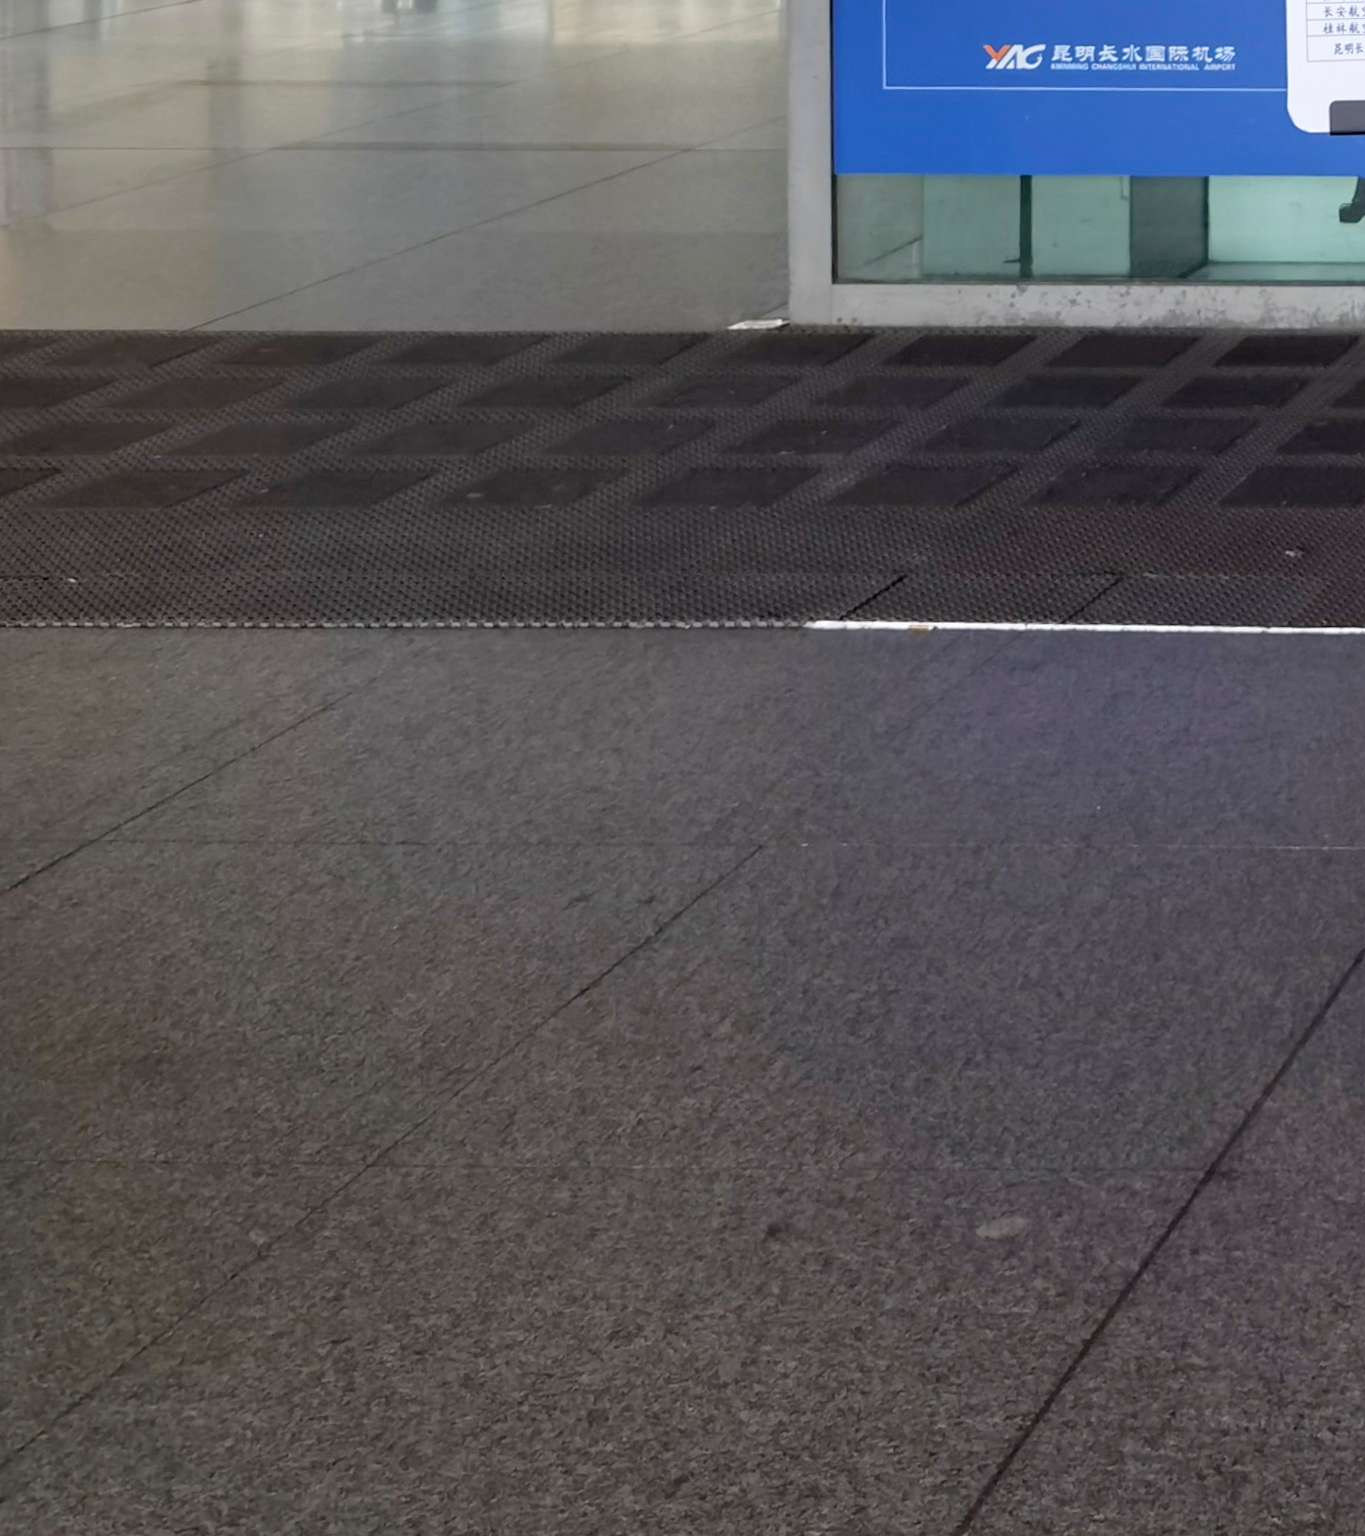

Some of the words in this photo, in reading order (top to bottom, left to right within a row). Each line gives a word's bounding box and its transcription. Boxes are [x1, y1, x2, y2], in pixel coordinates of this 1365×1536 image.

[1050, 44, 1236, 62] 昆明长水国际机场
